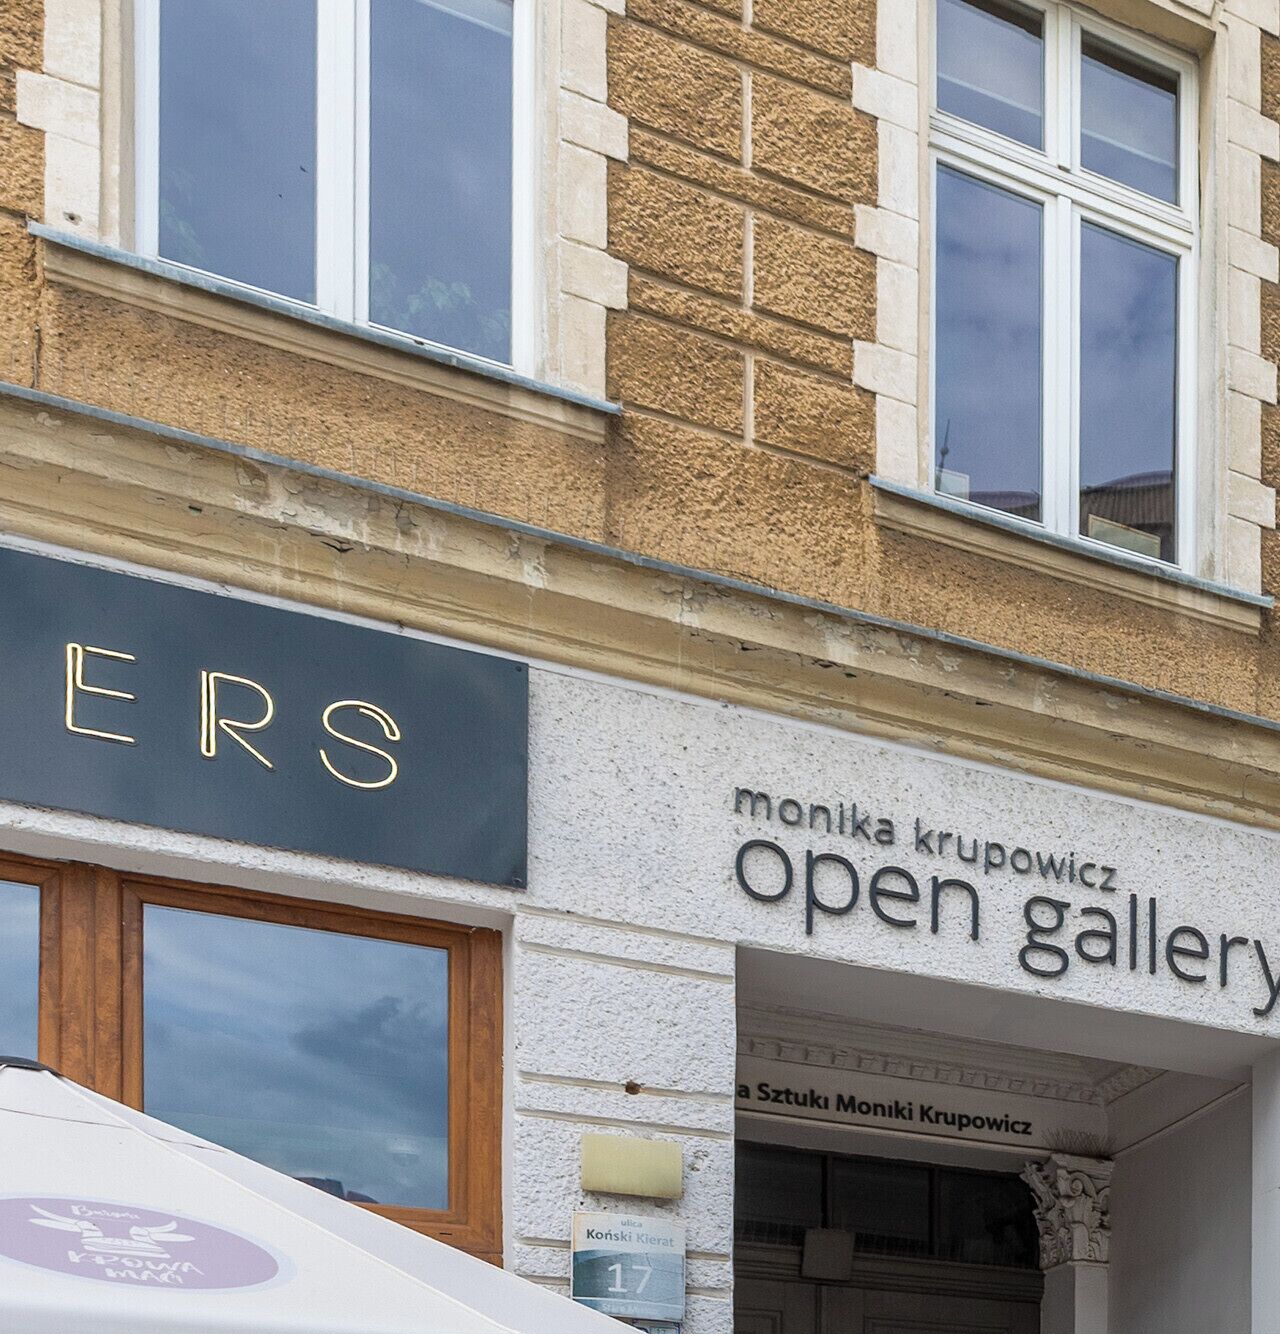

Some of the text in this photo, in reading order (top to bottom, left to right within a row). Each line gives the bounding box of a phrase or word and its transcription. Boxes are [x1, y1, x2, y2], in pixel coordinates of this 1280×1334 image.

[734, 786, 1118, 891] monika krupowicz
[735, 838, 980, 941] open
[757, 1082, 830, 1110] Sztuki
[836, 1094, 913, 1121] Moniki
[919, 1104, 1032, 1136] Krupowicz
[586, 1228, 674, 1248] Koński Kierat
[620, 1219, 643, 1228] ulica
[608, 1263, 653, 1294] 17
